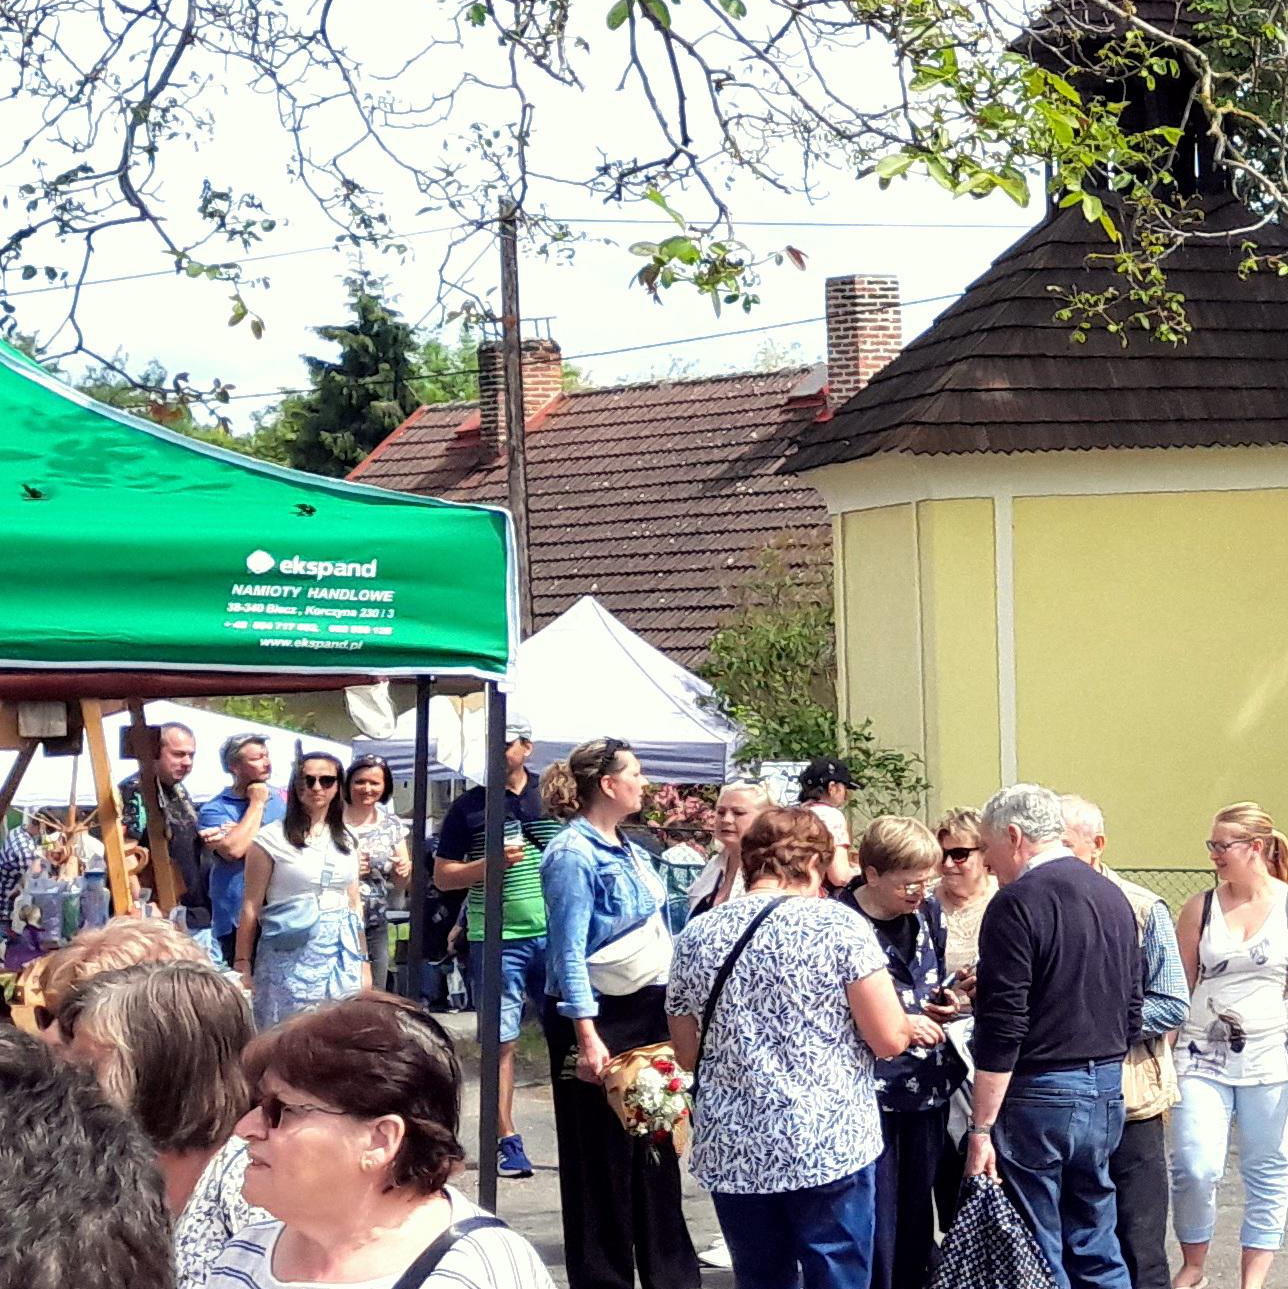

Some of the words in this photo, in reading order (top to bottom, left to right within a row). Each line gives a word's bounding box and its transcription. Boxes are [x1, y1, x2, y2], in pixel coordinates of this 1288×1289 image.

[279, 554, 378, 580] ekspand
[231, 583, 303, 598] NAMIOTY
[307, 587, 396, 602] HANDLOWE
[259, 637, 364, 650] www.ekspand.pl
